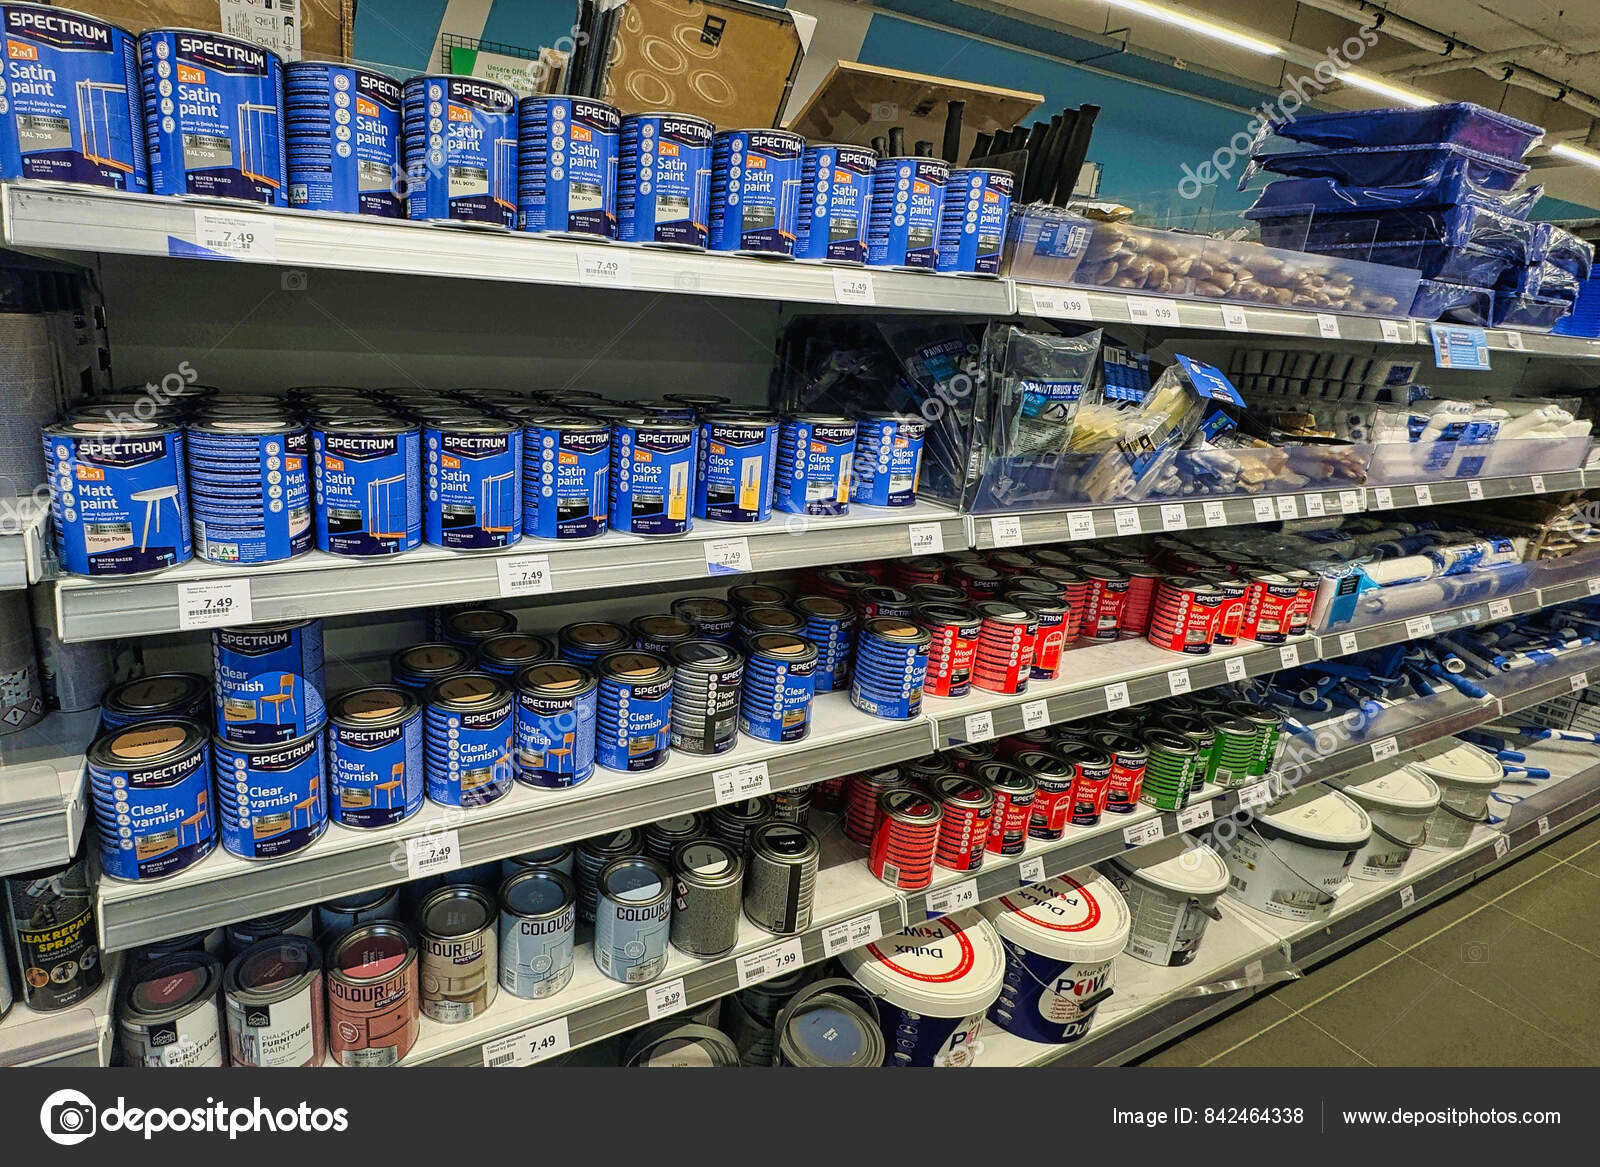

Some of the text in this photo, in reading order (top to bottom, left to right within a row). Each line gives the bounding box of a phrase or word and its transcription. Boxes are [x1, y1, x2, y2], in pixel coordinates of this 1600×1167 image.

[9, 12, 108, 44] SPECTRUM
[180, 38, 264, 67] SPECTRUM
[9, 62, 56, 82] Satin
[11, 80, 55, 98] paint
[178, 85, 221, 105] Satin
[452, 82, 514, 106] SPECTRUM
[179, 102, 219, 119] paint
[356, 116, 389, 136] Satin
[448, 124, 483, 139] Satin
[356, 132, 387, 148] paint
[448, 139, 481, 152] paint
[569, 141, 601, 158] Satin
[569, 156, 598, 169] paint
[656, 157, 687, 171] Satin
[656, 170, 685, 184] paint
[744, 170, 774, 183] Satin
[743, 181, 771, 194] paint
[831, 184, 858, 198] Satin
[831, 195, 856, 208] paint
[911, 195, 935, 208] Satin
[910, 205, 933, 217] paint
[982, 204, 1003, 216] Satin
[980, 213, 1002, 225] paint
[224, 232, 254, 243] 7.49
[597, 261, 618, 270] 7.49
[851, 283, 867, 291] 7.49
[1064, 302, 1081, 310] 0.99
[1156, 309, 1171, 318] 0.99
[563, 433, 610, 445] SPECTRUM
[638, 432, 690, 445] SPECTRUM
[714, 428, 764, 440] SPECTRUM
[79, 441, 163, 456] SPECTRUM
[328, 437, 394, 449] SPECTRUM
[445, 437, 506, 448] SPECTRUM
[708, 454, 734, 466] Gloss
[809, 453, 834, 465] Gloss
[893, 449, 914, 459] Gloss
[808, 462, 830, 473] paint
[892, 457, 911, 466] paint
[557, 465, 586, 476] Satin
[633, 463, 662, 475] Gloss
[708, 463, 730, 475] paint
[286, 474, 305, 484] Matt
[326, 471, 355, 485] Satin
[440, 470, 470, 482] Satin
[557, 476, 584, 488] paint
[632, 472, 658, 484] paint
[79, 485, 113, 496] Matt
[287, 485, 307, 500] paint
[326, 484, 353, 496] paint
[441, 482, 468, 494] paint
[80, 498, 119, 513] paint
[221, 546, 236, 556] A+
[723, 551, 741, 560] 7.49
[522, 571, 542, 580] 7.49
[205, 598, 232, 608] 7.49
[1263, 603, 1283, 611] Wood
[221, 634, 288, 644] SPECTRUM
[953, 655, 970, 664] paint
[221, 665, 248, 679] Clear
[221, 679, 264, 692] varnish
[785, 686, 806, 696] Clear
[522, 696, 573, 708] SPECTRUM
[717, 692, 735, 701] Floor
[784, 693, 811, 705] varnish
[717, 698, 736, 709] paint
[464, 705, 511, 725] SPECTRUM
[629, 712, 653, 721] Clear
[519, 721, 541, 734] Clear
[629, 718, 662, 731] varnish
[340, 728, 400, 740] SPECTRUM
[519, 733, 551, 746] varnish
[252, 740, 315, 765] SPECTRUM
[460, 743, 488, 753] Clear
[460, 749, 498, 763] varnish
[132, 754, 202, 783] SPECTRUM
[339, 758, 365, 771] Clear
[339, 771, 378, 782] varnish
[748, 775, 764, 783] 7.49
[1111, 774, 1132, 782] Wood
[250, 786, 284, 798] Clear
[1078, 786, 1097, 794] Wood
[250, 793, 298, 808] varnish
[131, 802, 168, 817] Clear
[1198, 810, 1210, 820] 4.99
[132, 808, 185, 828] varnish
[1005, 819, 1022, 827] paint
[1147, 828, 1159, 837] 5.17
[430, 846, 451, 858] 7.49
[957, 891, 972, 900] 7.49
[1017, 890, 1066, 916] Dulux
[21, 913, 92, 944] LEAK REPAIR
[858, 924, 871, 934] 7.99
[38, 931, 80, 953] SPRAY
[895, 944, 944, 958] Dulux
[776, 953, 796, 967] 7.99
[330, 976, 408, 1001] COLOURFUL
[664, 992, 680, 1004] 8.99
[261, 1028, 292, 1041] CHALKY
[262, 1022, 310, 1047] FURNITURE
[262, 1042, 291, 1055] PAINT
[530, 1036, 556, 1053] 7.49
